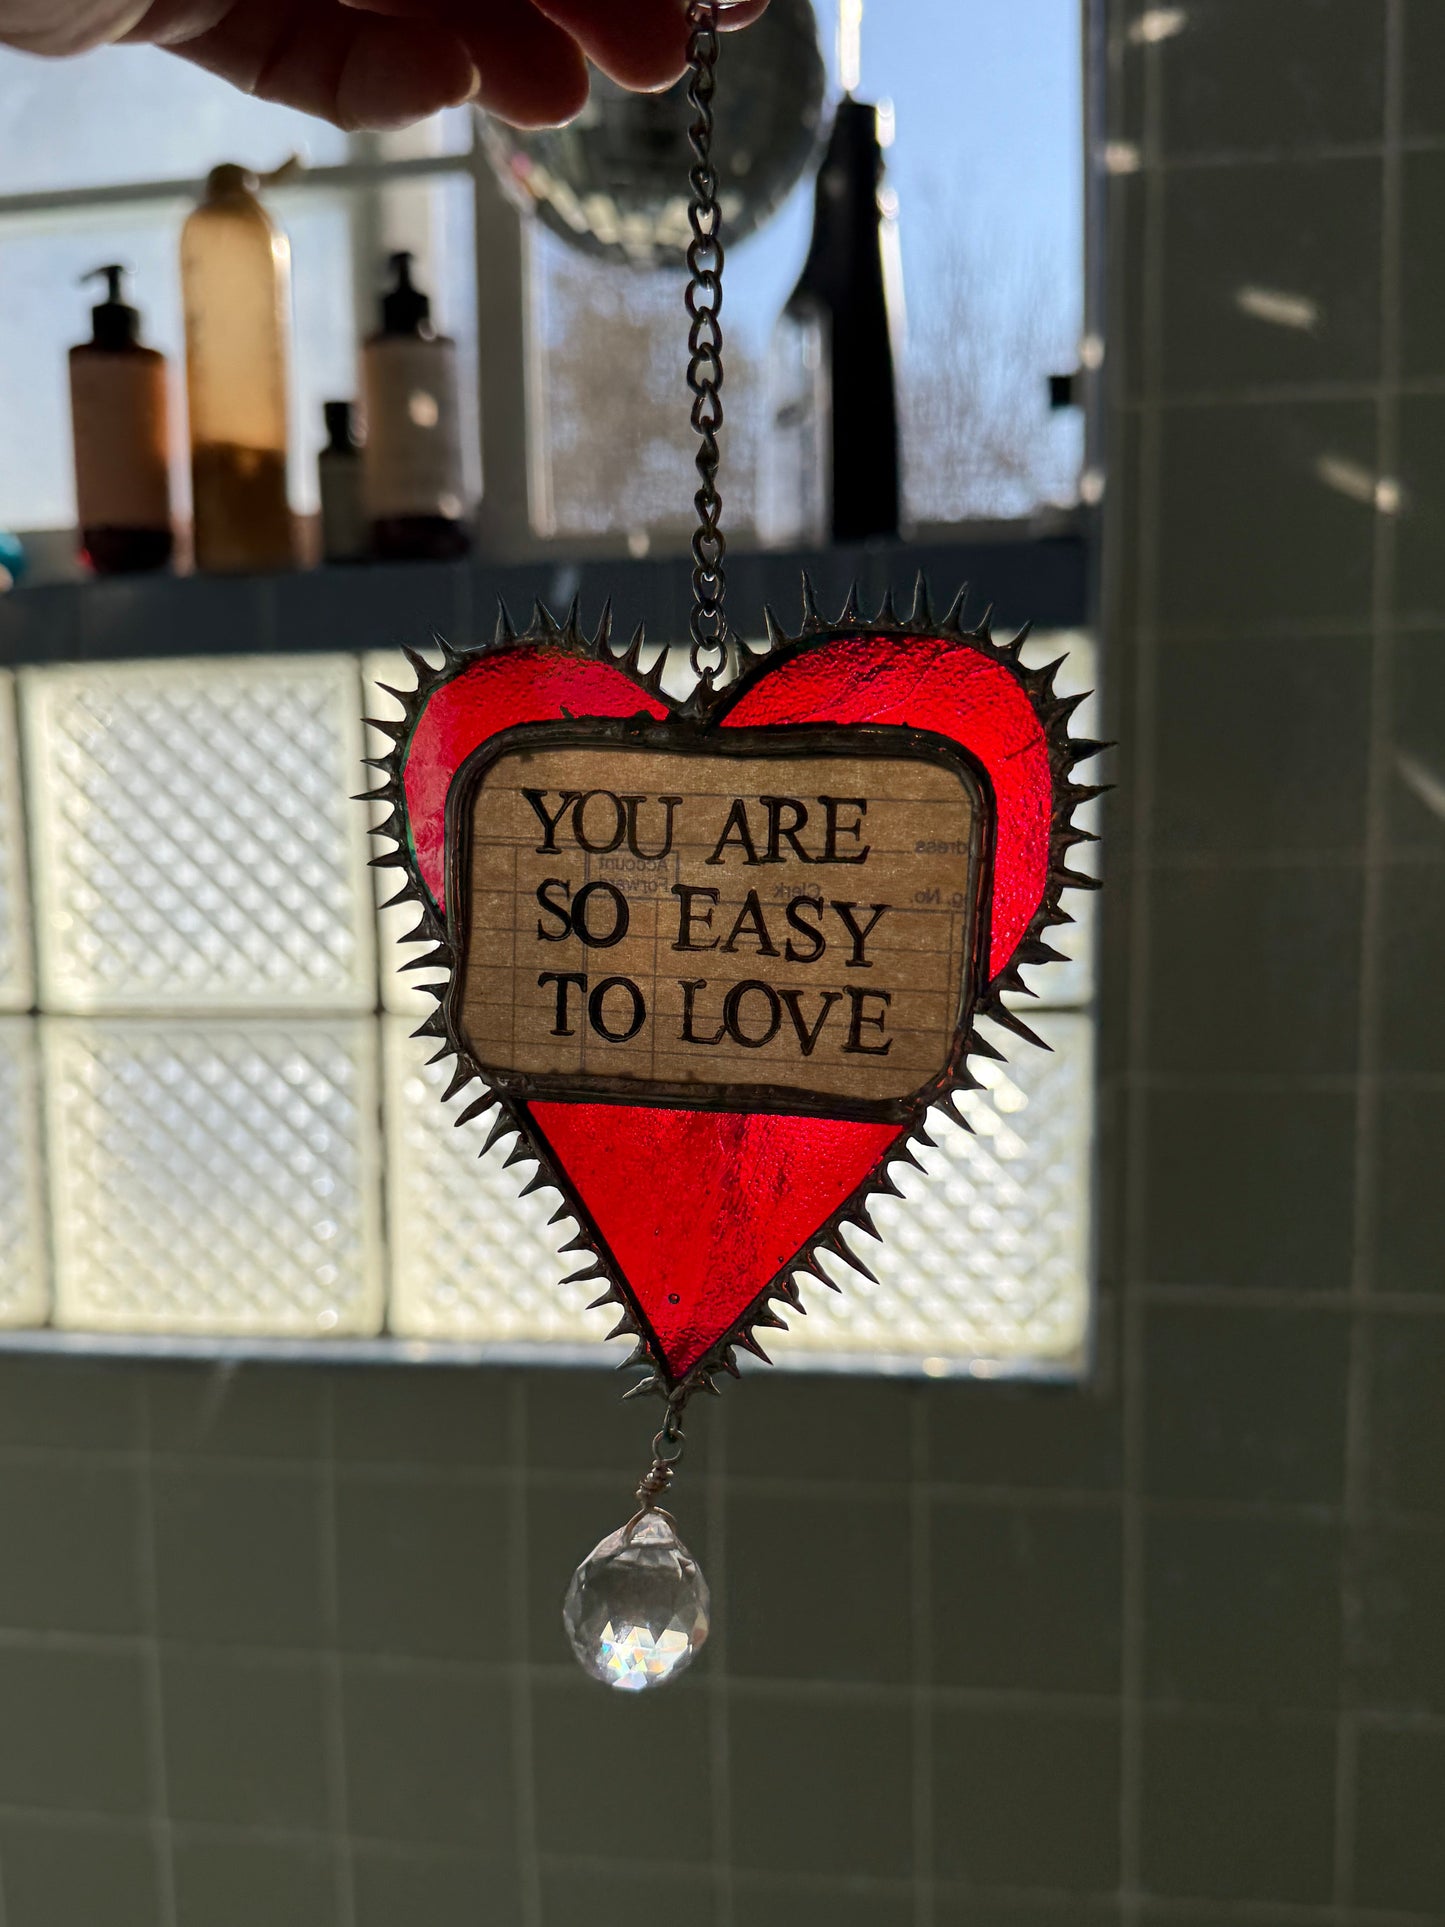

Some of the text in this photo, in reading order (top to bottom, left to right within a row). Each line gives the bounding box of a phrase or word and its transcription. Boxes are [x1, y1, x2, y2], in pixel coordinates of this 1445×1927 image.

[522, 788, 870, 866] YOU ARE
[536, 878, 892, 968] SO EASY
[537, 972, 894, 1057] TO LOVE
